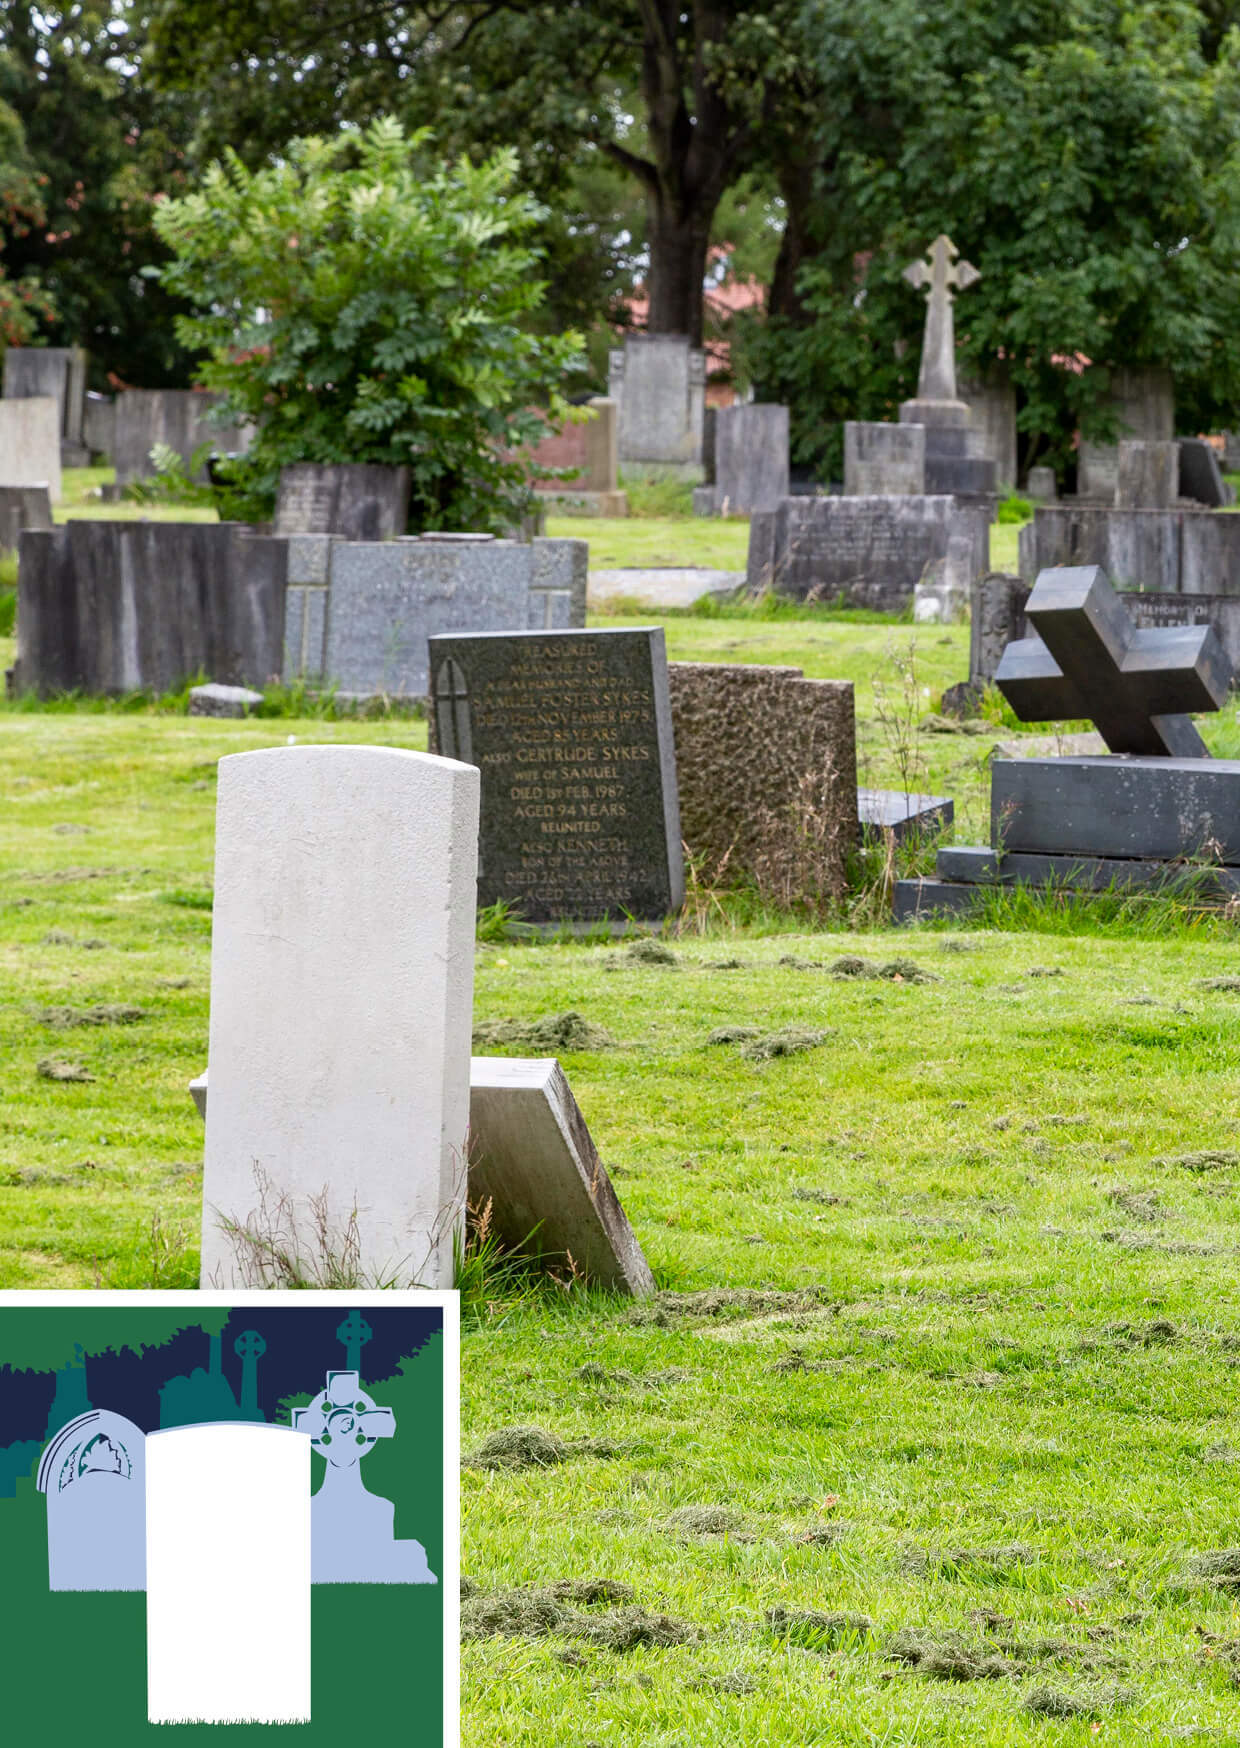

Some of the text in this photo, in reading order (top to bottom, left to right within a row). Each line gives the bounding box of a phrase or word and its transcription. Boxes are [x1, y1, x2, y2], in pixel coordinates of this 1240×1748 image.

[602, 690, 649, 706] SYKES
[572, 727, 618, 742] YEARS
[515, 747, 597, 763] GERTRUDE
[602, 745, 649, 761] SYKES
[514, 766, 620, 781] WIFE OF SAMUEL
[511, 786, 544, 800] DIED
[513, 802, 628, 818] AGED 94 YEARS
[541, 820, 601, 833] REUNITED
